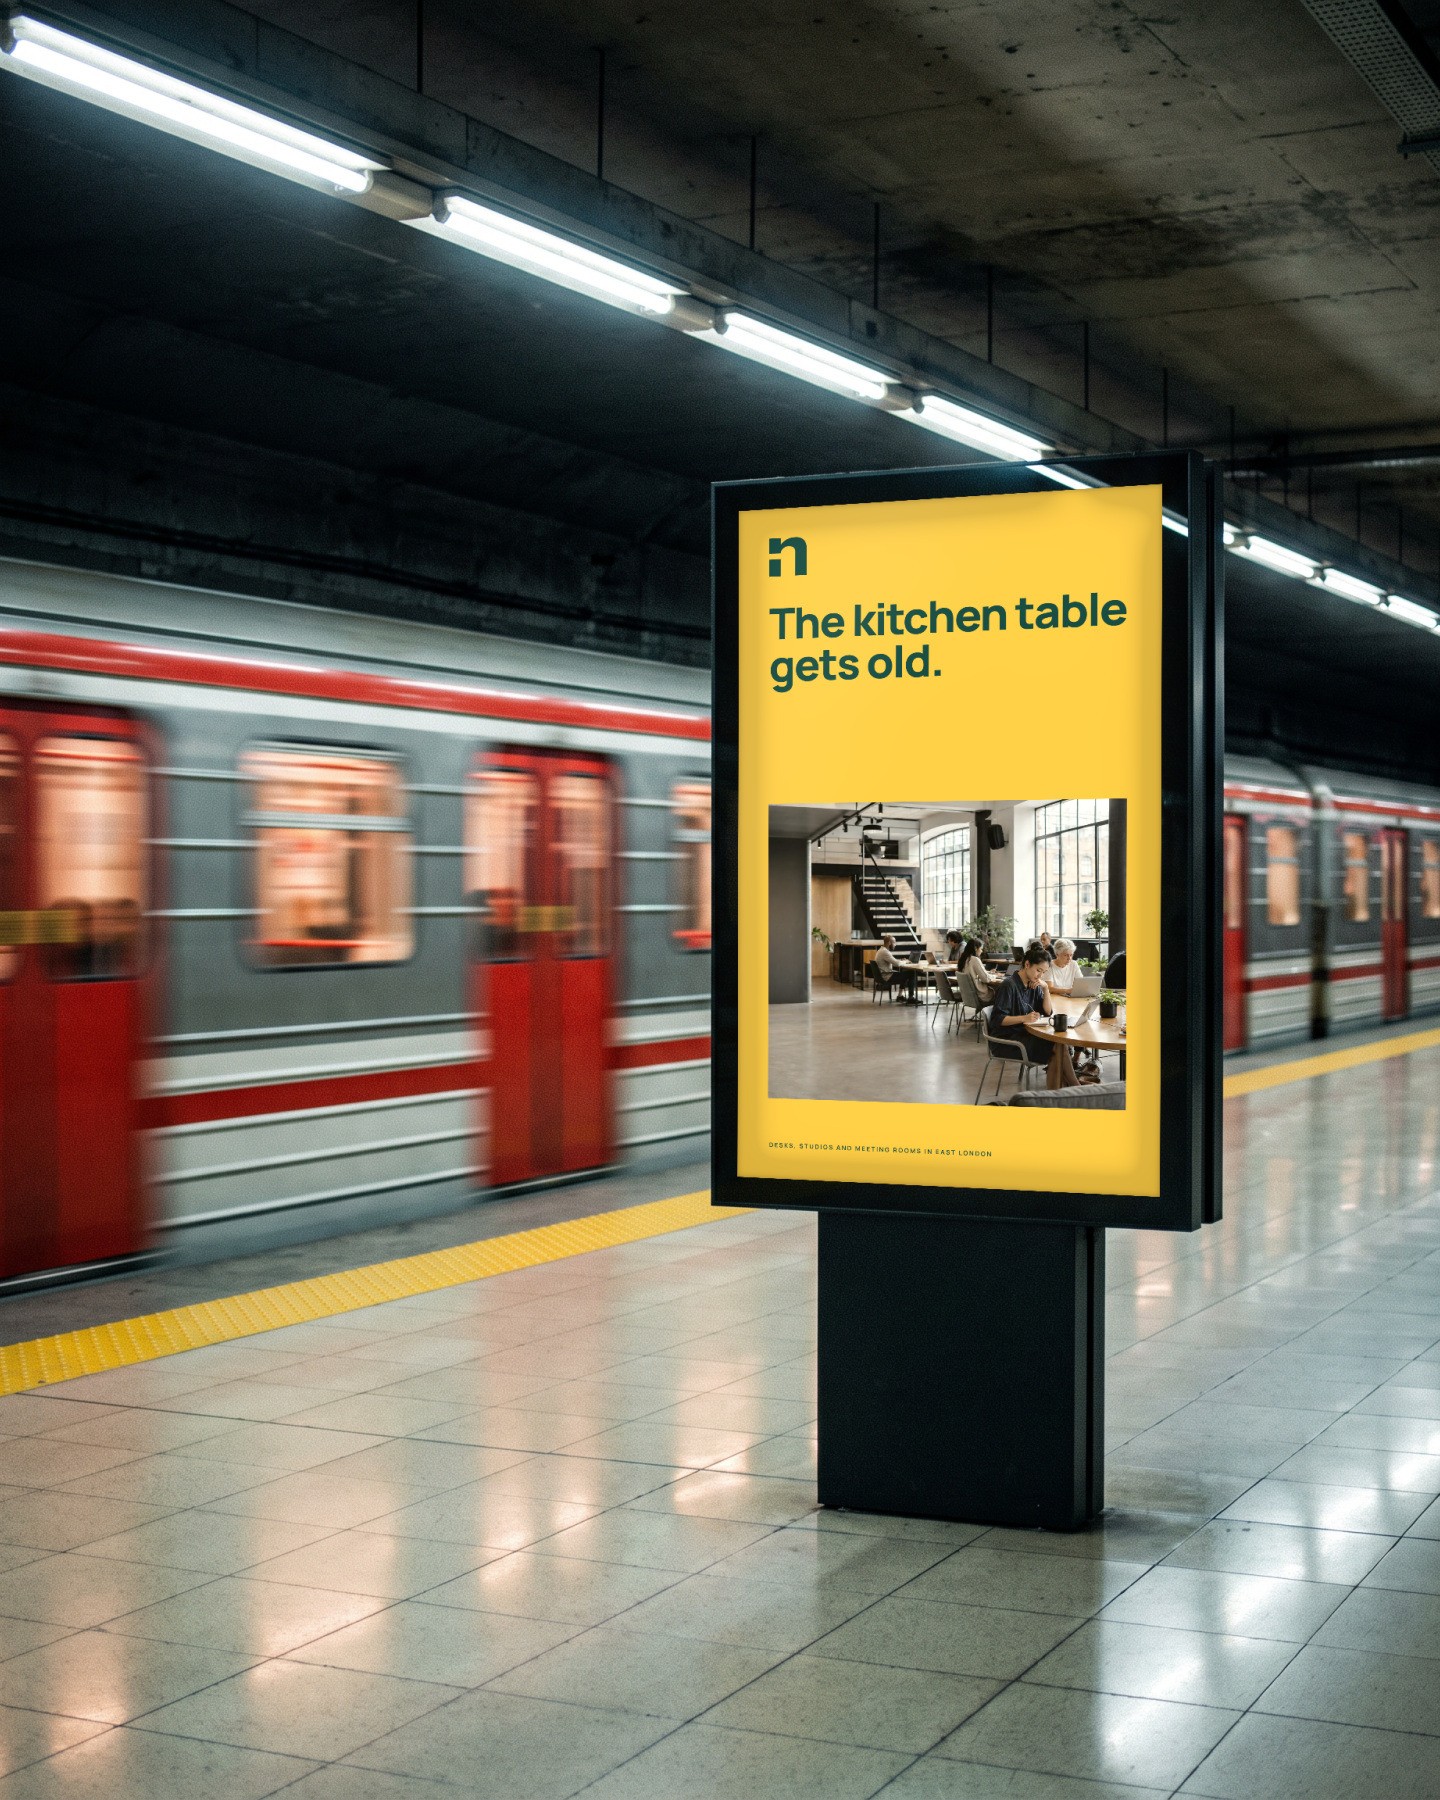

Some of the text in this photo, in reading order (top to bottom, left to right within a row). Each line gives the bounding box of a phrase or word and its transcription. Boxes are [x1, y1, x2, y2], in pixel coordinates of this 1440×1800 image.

[769, 593, 1128, 640] The kitchen table
[770, 643, 942, 694] gets old.
[799, 1142, 834, 1151] STUDIOS
[854, 1145, 890, 1154] MEETING
[958, 1150, 993, 1158] LONDON
